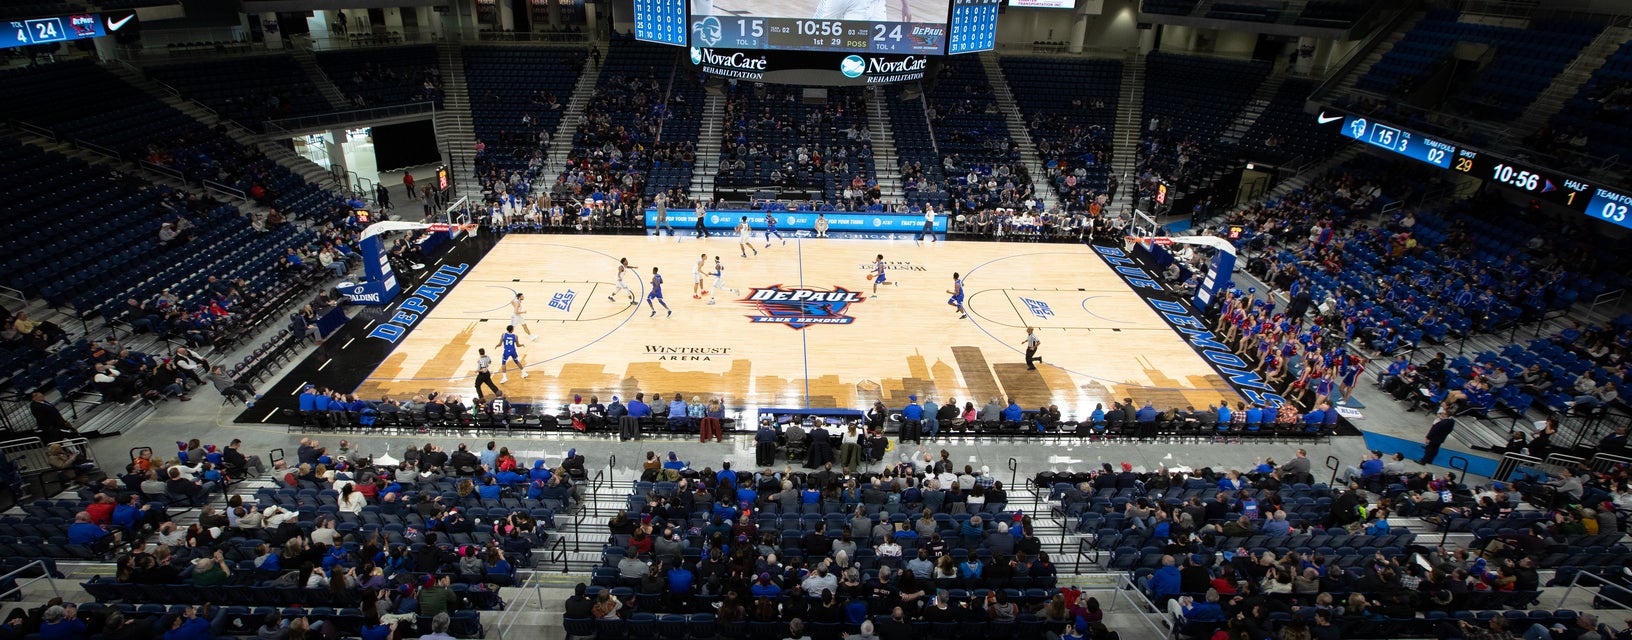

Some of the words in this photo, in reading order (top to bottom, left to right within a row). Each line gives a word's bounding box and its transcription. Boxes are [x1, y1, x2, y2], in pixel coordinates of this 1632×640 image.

[17, 29, 26, 42] 4
[36, 22, 57, 38] 24
[738, 20, 763, 37] 15
[796, 20, 842, 36] 10:56
[873, 24, 902, 42] 24
[702, 48, 767, 70] NovaCare
[866, 56, 926, 73] NovaCare
[703, 66, 763, 79] REHABILITATION
[867, 72, 924, 83] REHABILITATION
[1378, 129, 1393, 144] 15
[1399, 139, 1408, 151] 3
[1424, 138, 1439, 148] TEAM
[1438, 142, 1455, 152] FOULS
[1428, 148, 1444, 163] 02
[1460, 150, 1477, 159] SHOT
[1456, 158, 1472, 172] 29
[1493, 164, 1540, 190] 10:56
[1564, 180, 1589, 192] HALF
[1567, 192, 1576, 205] 1
[1596, 189, 1620, 201] TEAM
[1602, 202, 1628, 222] 03
[366, 263, 469, 343] DEPAUL
[548, 292, 563, 307] BIG
[557, 289, 575, 310] EAST
[1092, 245, 1164, 290] BLUE
[1147, 297, 1286, 409] DEMONS
[493, 403, 504, 413] 51
